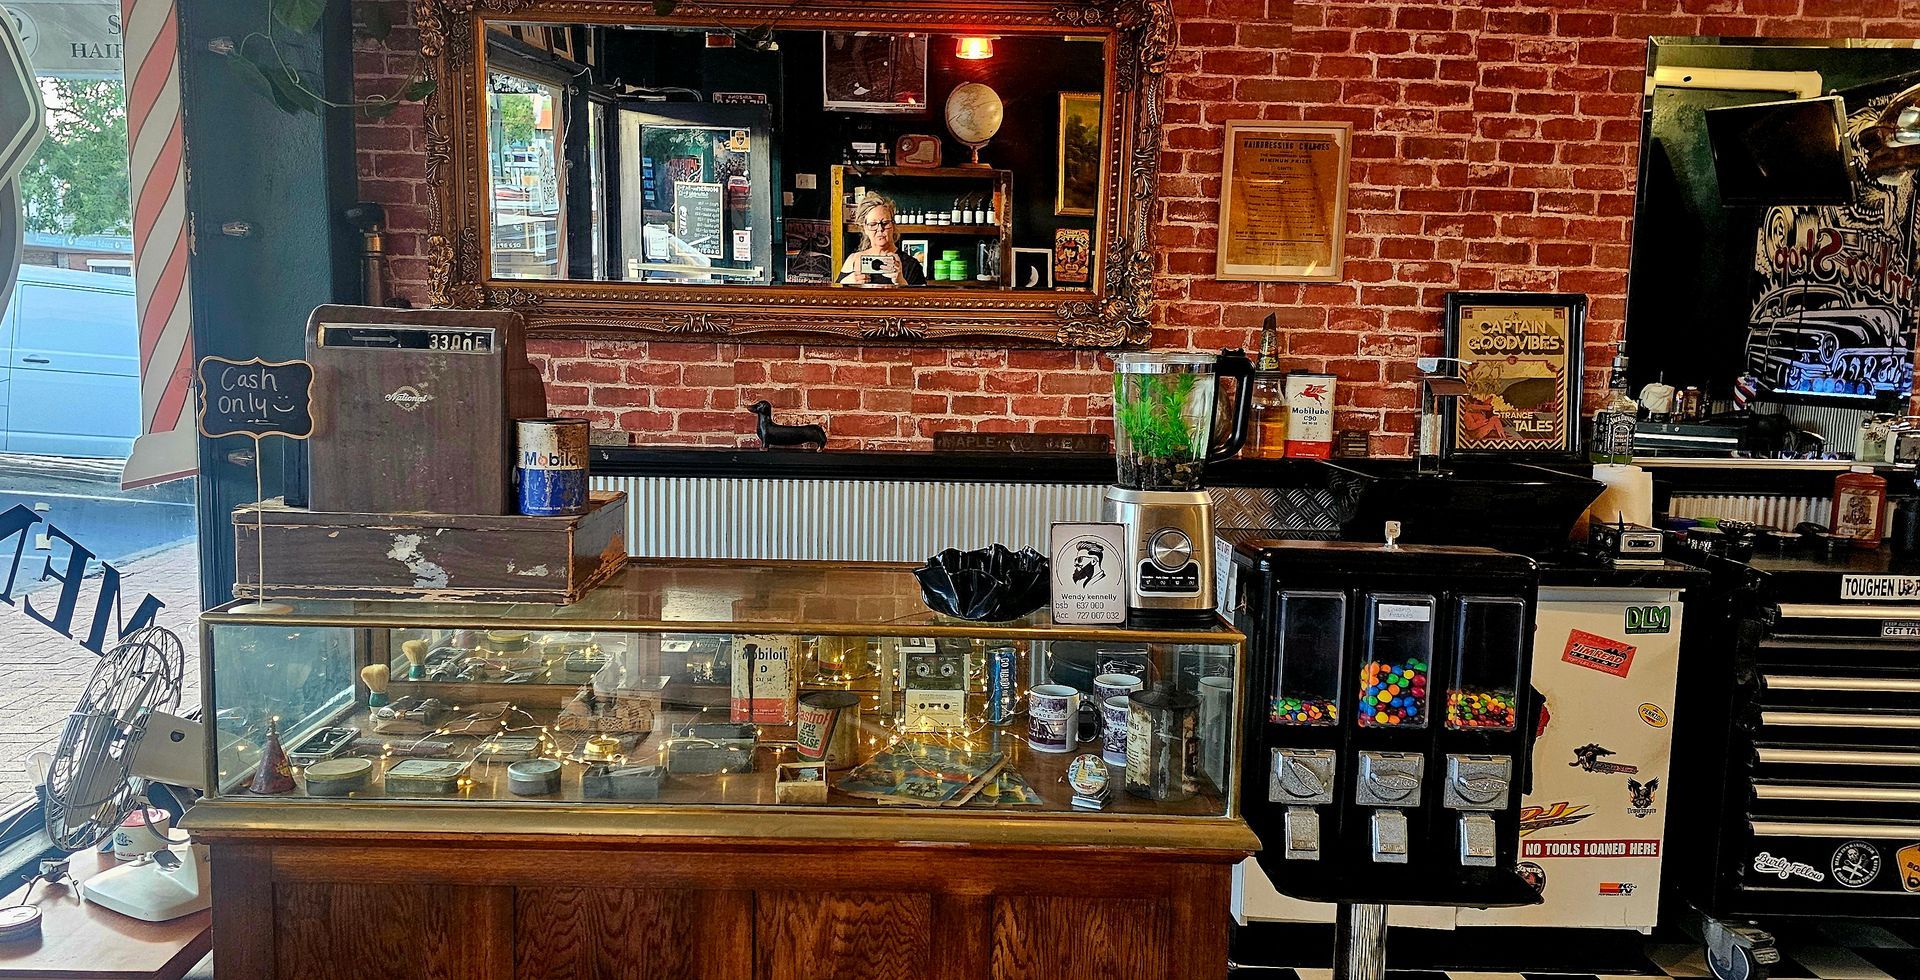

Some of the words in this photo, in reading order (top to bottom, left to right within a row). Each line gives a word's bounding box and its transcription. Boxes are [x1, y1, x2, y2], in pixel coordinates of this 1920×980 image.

[1244, 140, 1294, 150] HAIRDRESSING
[1299, 142, 1330, 151] CHARGES
[1479, 320, 1546, 334] CAPTAIN
[1468, 335, 1560, 350] GOODVIBES
[221, 366, 278, 392] Cash
[384, 393, 428, 402] National
[1292, 407, 1330, 415] Mobilube
[1492, 410, 1534, 419] STRANGE
[1513, 420, 1554, 432] TALES
[940, 436, 997, 448] MAPLE
[1845, 578, 1894, 596] TOUGHEN
[1626, 606, 1671, 629] DLM
[1574, 643, 1596, 656] JIM
[1594, 650, 1625, 664] READ
[1001, 657, 1009, 667] GO
[1642, 708, 1664, 722] PENNZOIL
[1525, 843, 1542, 856] NO
[1545, 843, 1581, 855] TOOLS
[1584, 843, 1626, 855] LOANED
[1629, 843, 1657, 855] HERE
[1757, 853, 1789, 877] Burly
[1790, 864, 1822, 880] Fellow
[1907, 863, 1920, 874] BO
